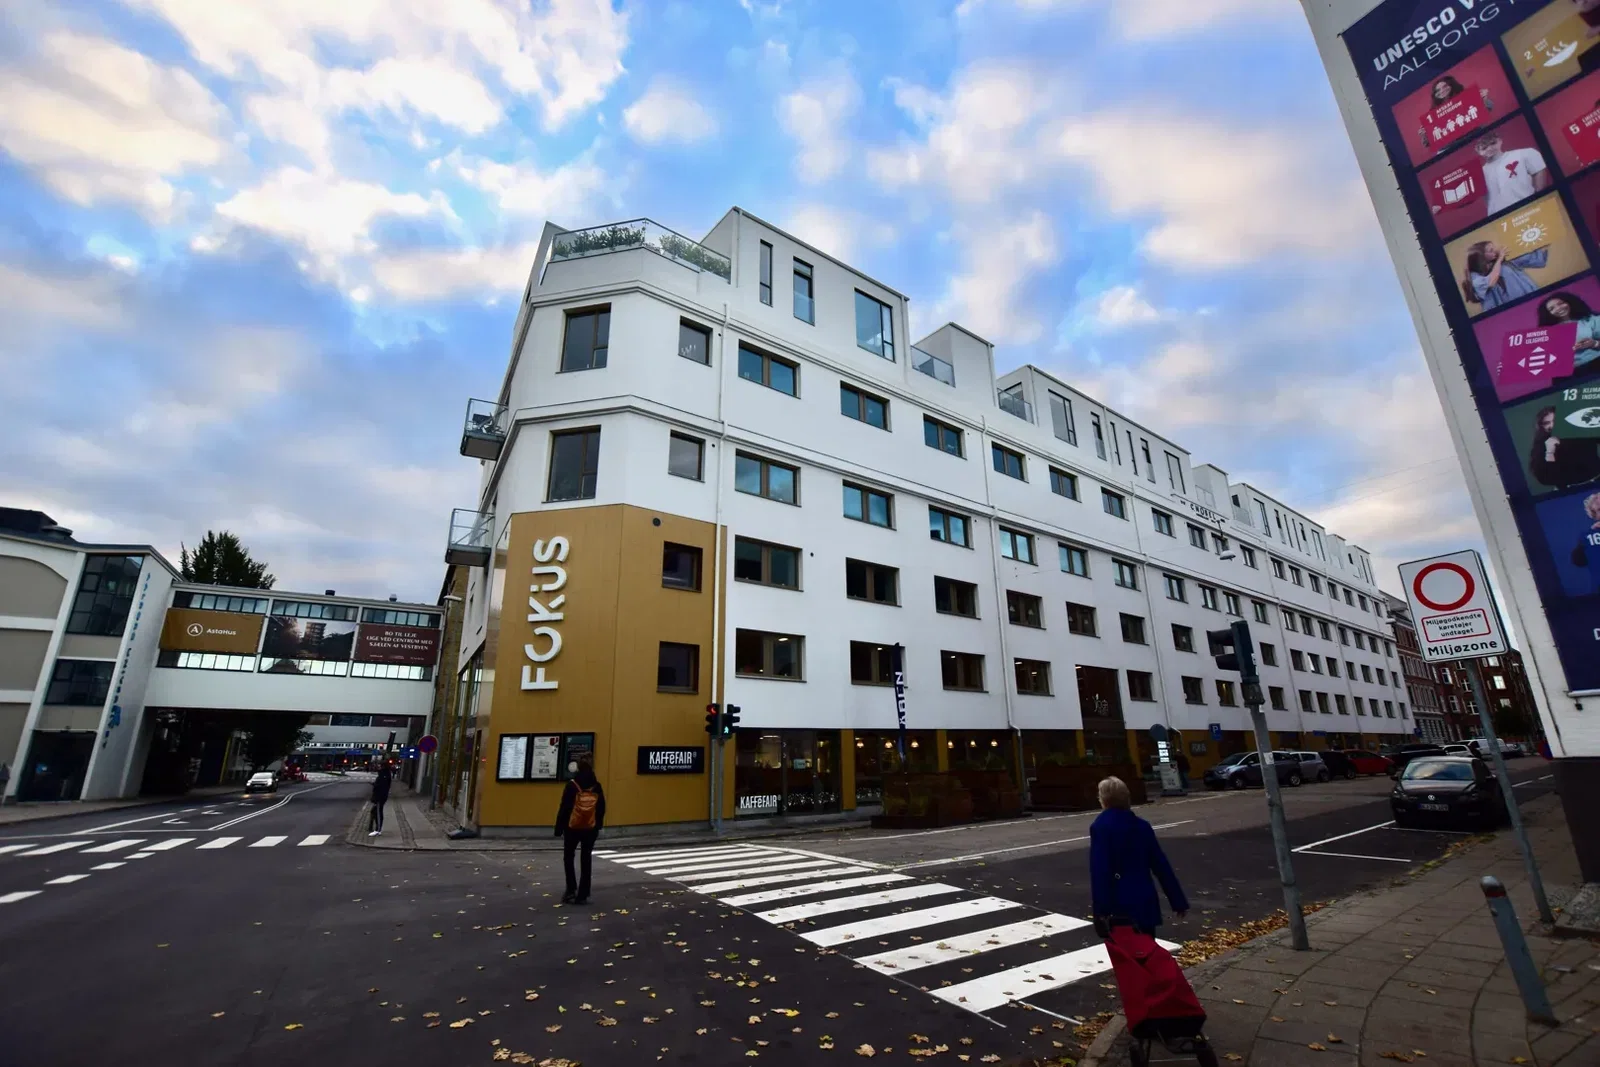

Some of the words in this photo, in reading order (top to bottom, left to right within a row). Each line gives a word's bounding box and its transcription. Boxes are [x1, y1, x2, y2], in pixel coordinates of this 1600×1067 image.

[1373, 7, 1456, 72] UNESCO
[1383, 2, 1500, 92] AALBORG
[1524, 51, 1533, 60] 2
[1426, 114, 1433, 123] 1
[1569, 123, 1580, 135] 5
[1434, 179, 1441, 188] 4
[1500, 221, 1507, 232] 7
[1508, 333, 1523, 347] 10
[1563, 388, 1578, 401] 13
[520, 535, 571, 691] FOKUS
[1425, 612, 1482, 626] Miljøgodkendte
[1438, 621, 1473, 631] køretøjer
[1441, 628, 1475, 637] undtaget
[1427, 640, 1498, 657] Miljøzone
